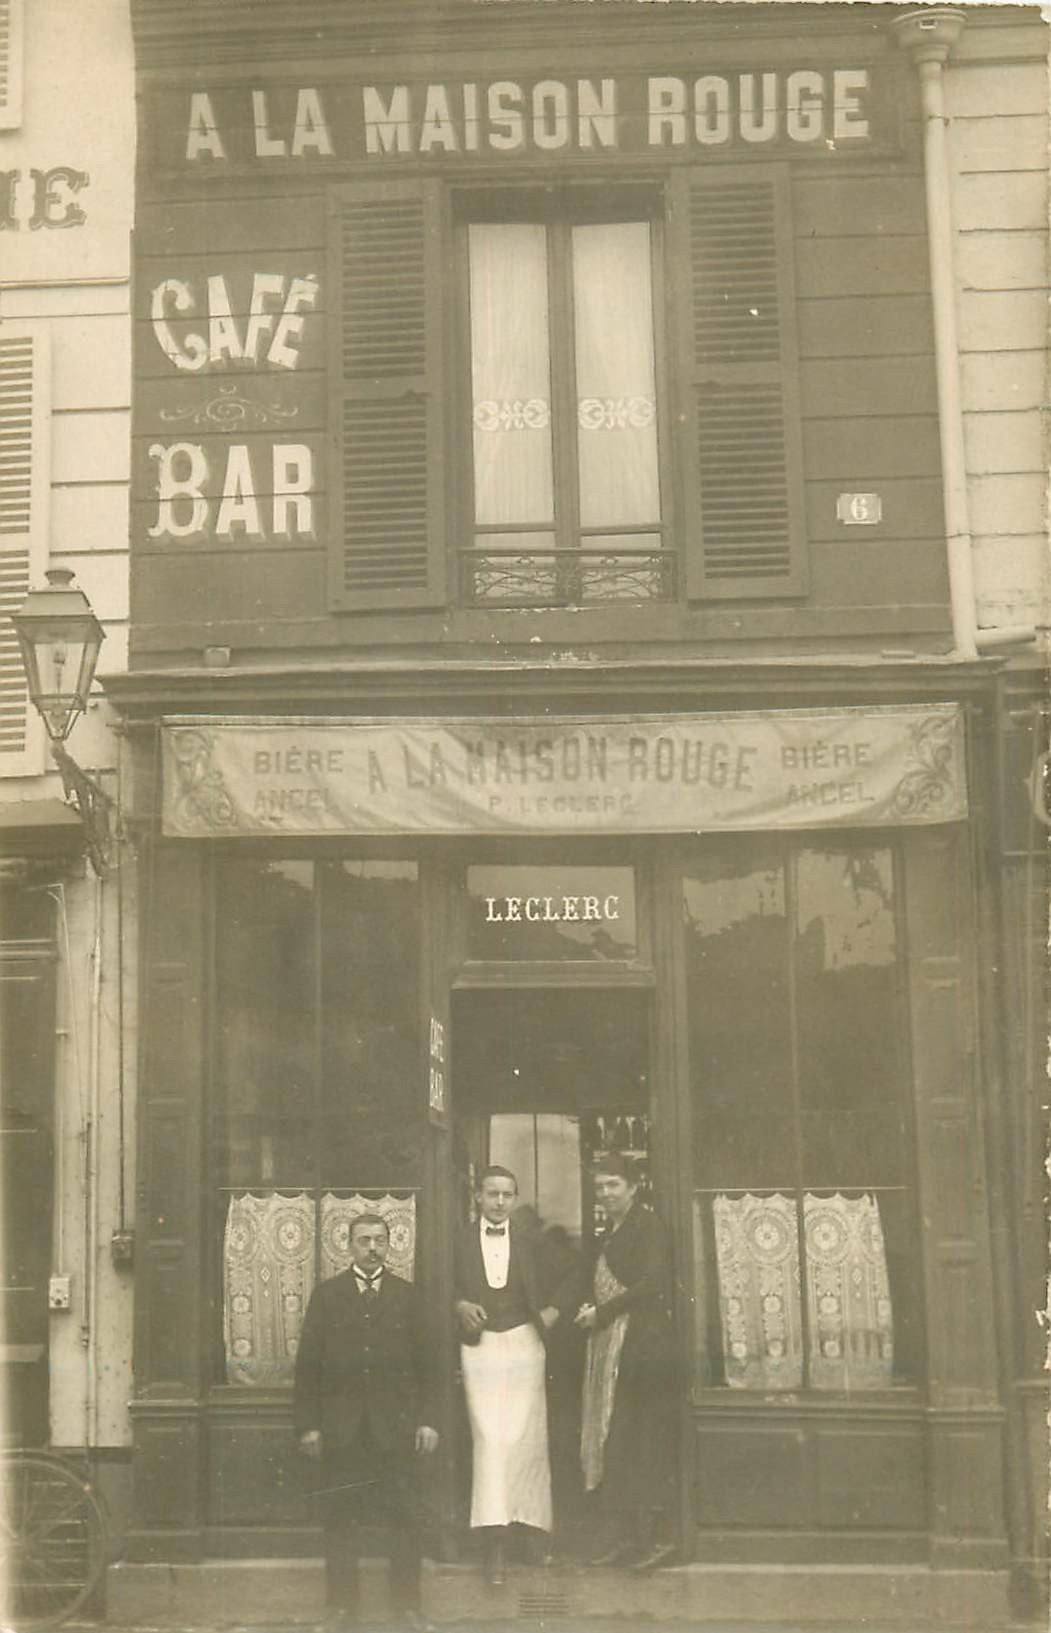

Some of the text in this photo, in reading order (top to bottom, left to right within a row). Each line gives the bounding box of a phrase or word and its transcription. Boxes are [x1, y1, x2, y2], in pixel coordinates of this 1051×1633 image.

[186, 70, 869, 159] A LA MAISON ROUGE
[148, 442, 315, 538] BAR
[850, 497, 868, 521] 6
[368, 736, 758, 795] A LA MAISON ROUGE
[484, 895, 620, 922] LECLERC
